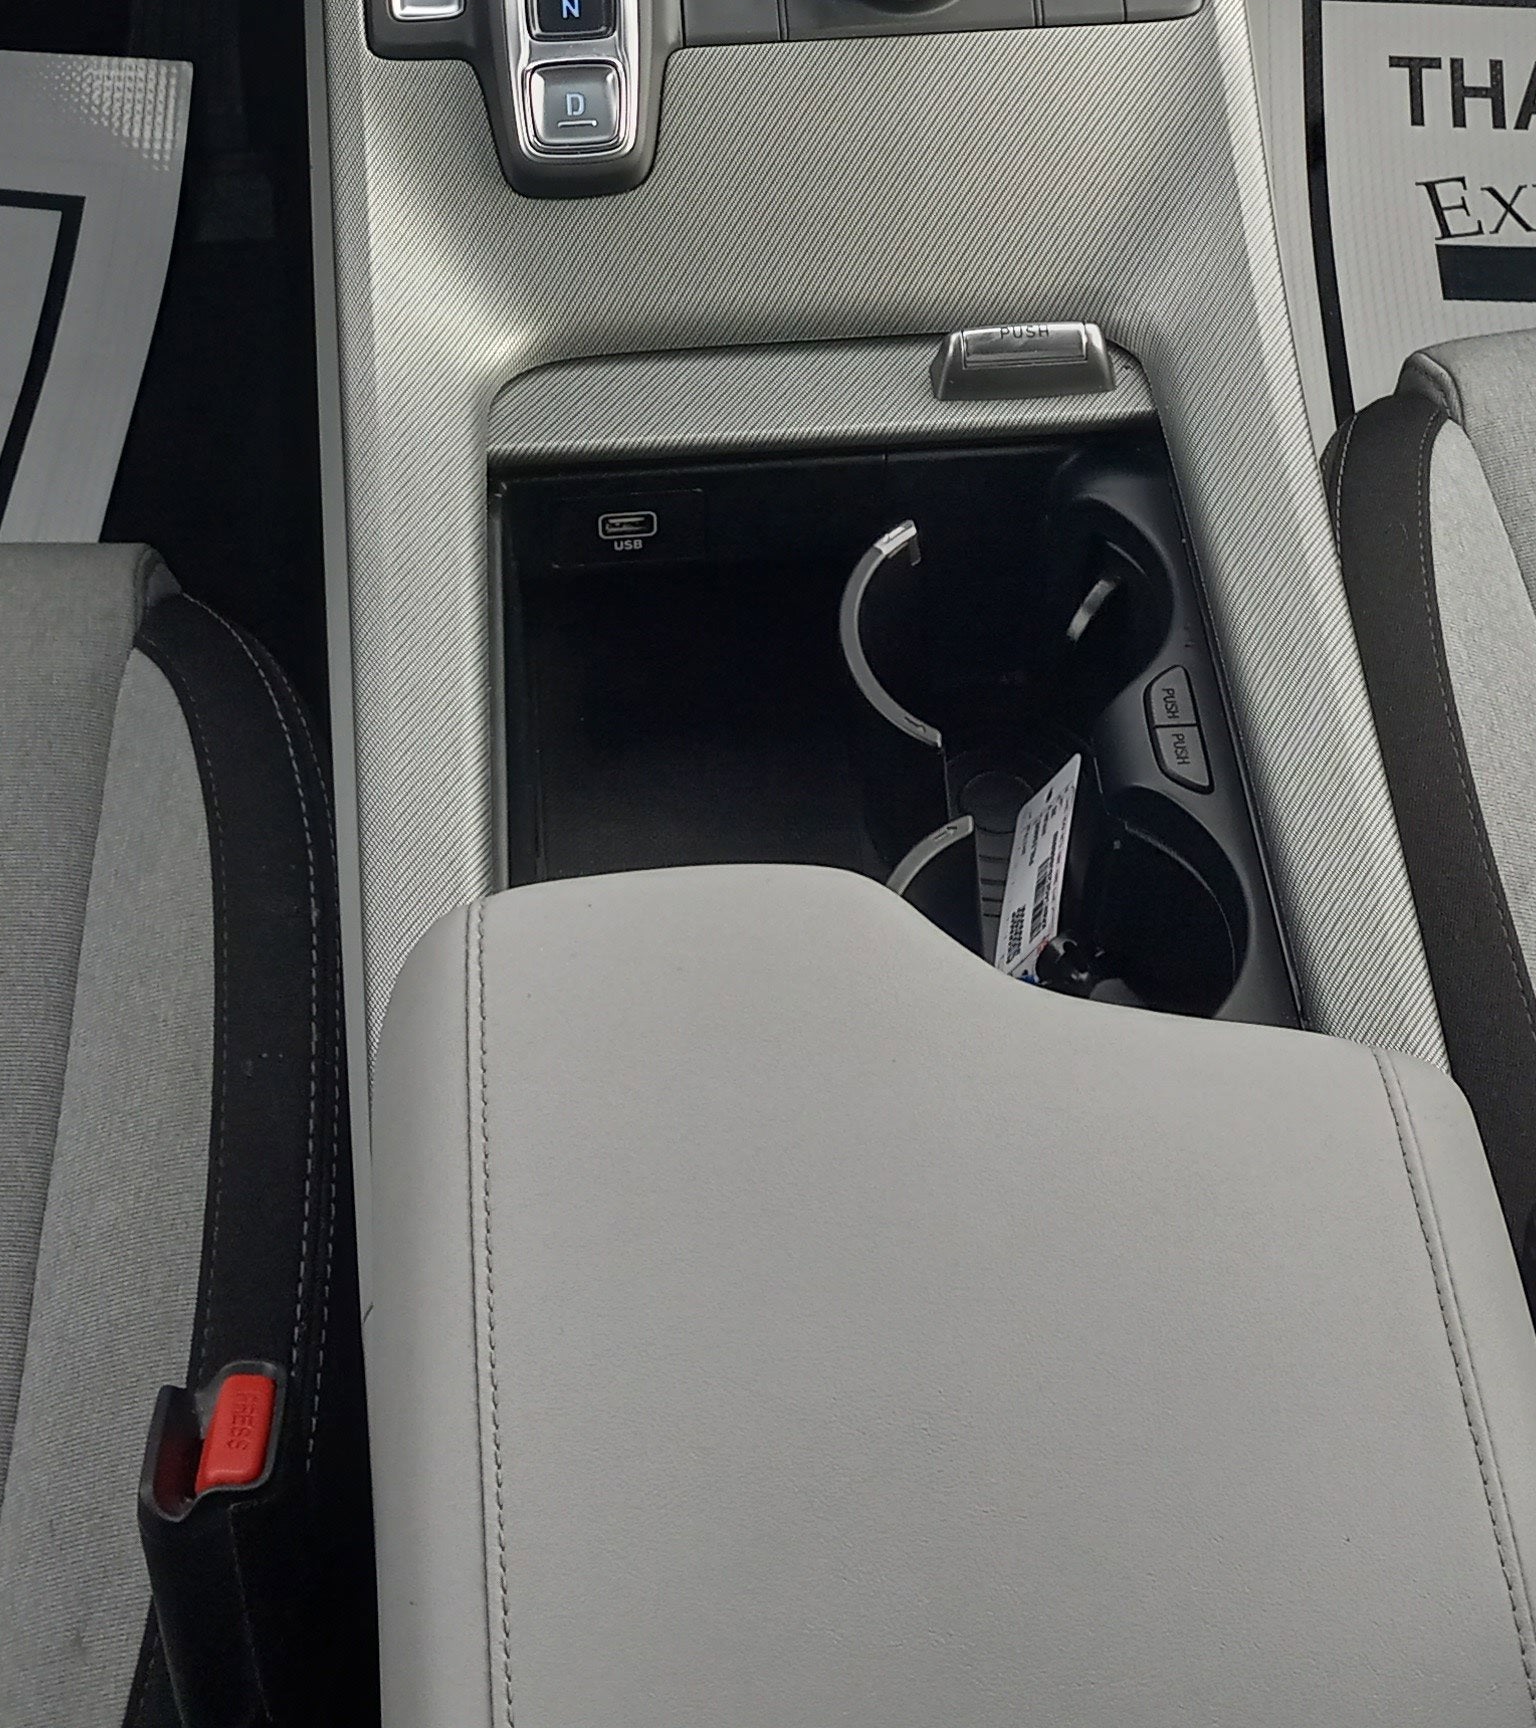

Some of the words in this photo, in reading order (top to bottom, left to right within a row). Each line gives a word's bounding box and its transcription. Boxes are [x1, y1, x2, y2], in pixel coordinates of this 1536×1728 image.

[566, 93, 586, 117] D
[1000, 324, 1050, 340] PUSH
[614, 539, 643, 551] USB
[1162, 688, 1179, 719] PUSH
[1172, 733, 1190, 764] PUSH
